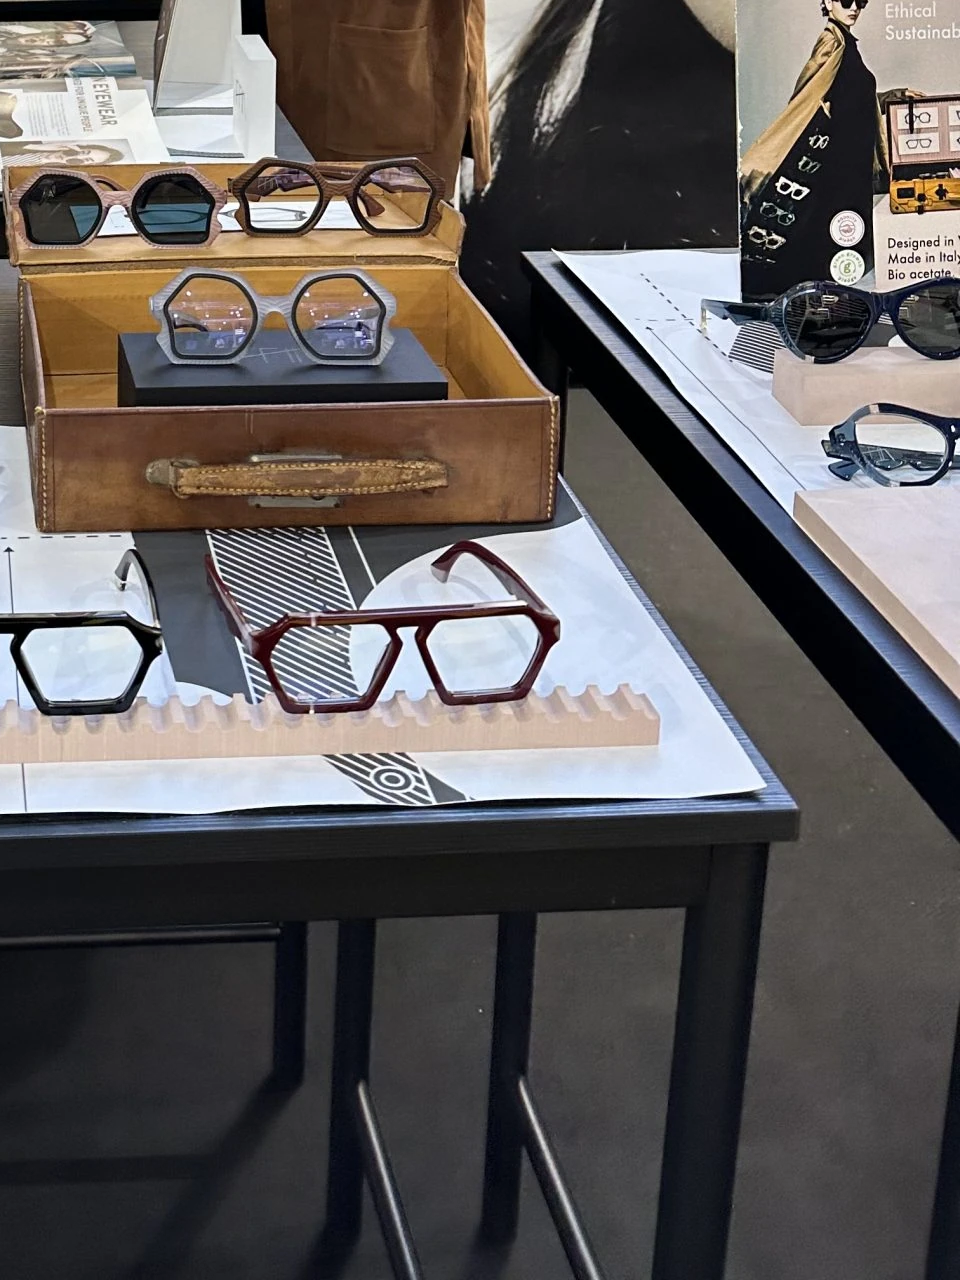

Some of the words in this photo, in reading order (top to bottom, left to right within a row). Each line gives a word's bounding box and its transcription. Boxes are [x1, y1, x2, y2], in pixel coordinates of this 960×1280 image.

[885, 1, 937, 18] Ethical
[887, 235, 940, 251] Designed
[944, 235, 954, 247] in
[887, 252, 921, 264] Made
[925, 252, 935, 263] in
[888, 269, 906, 280] Bio
